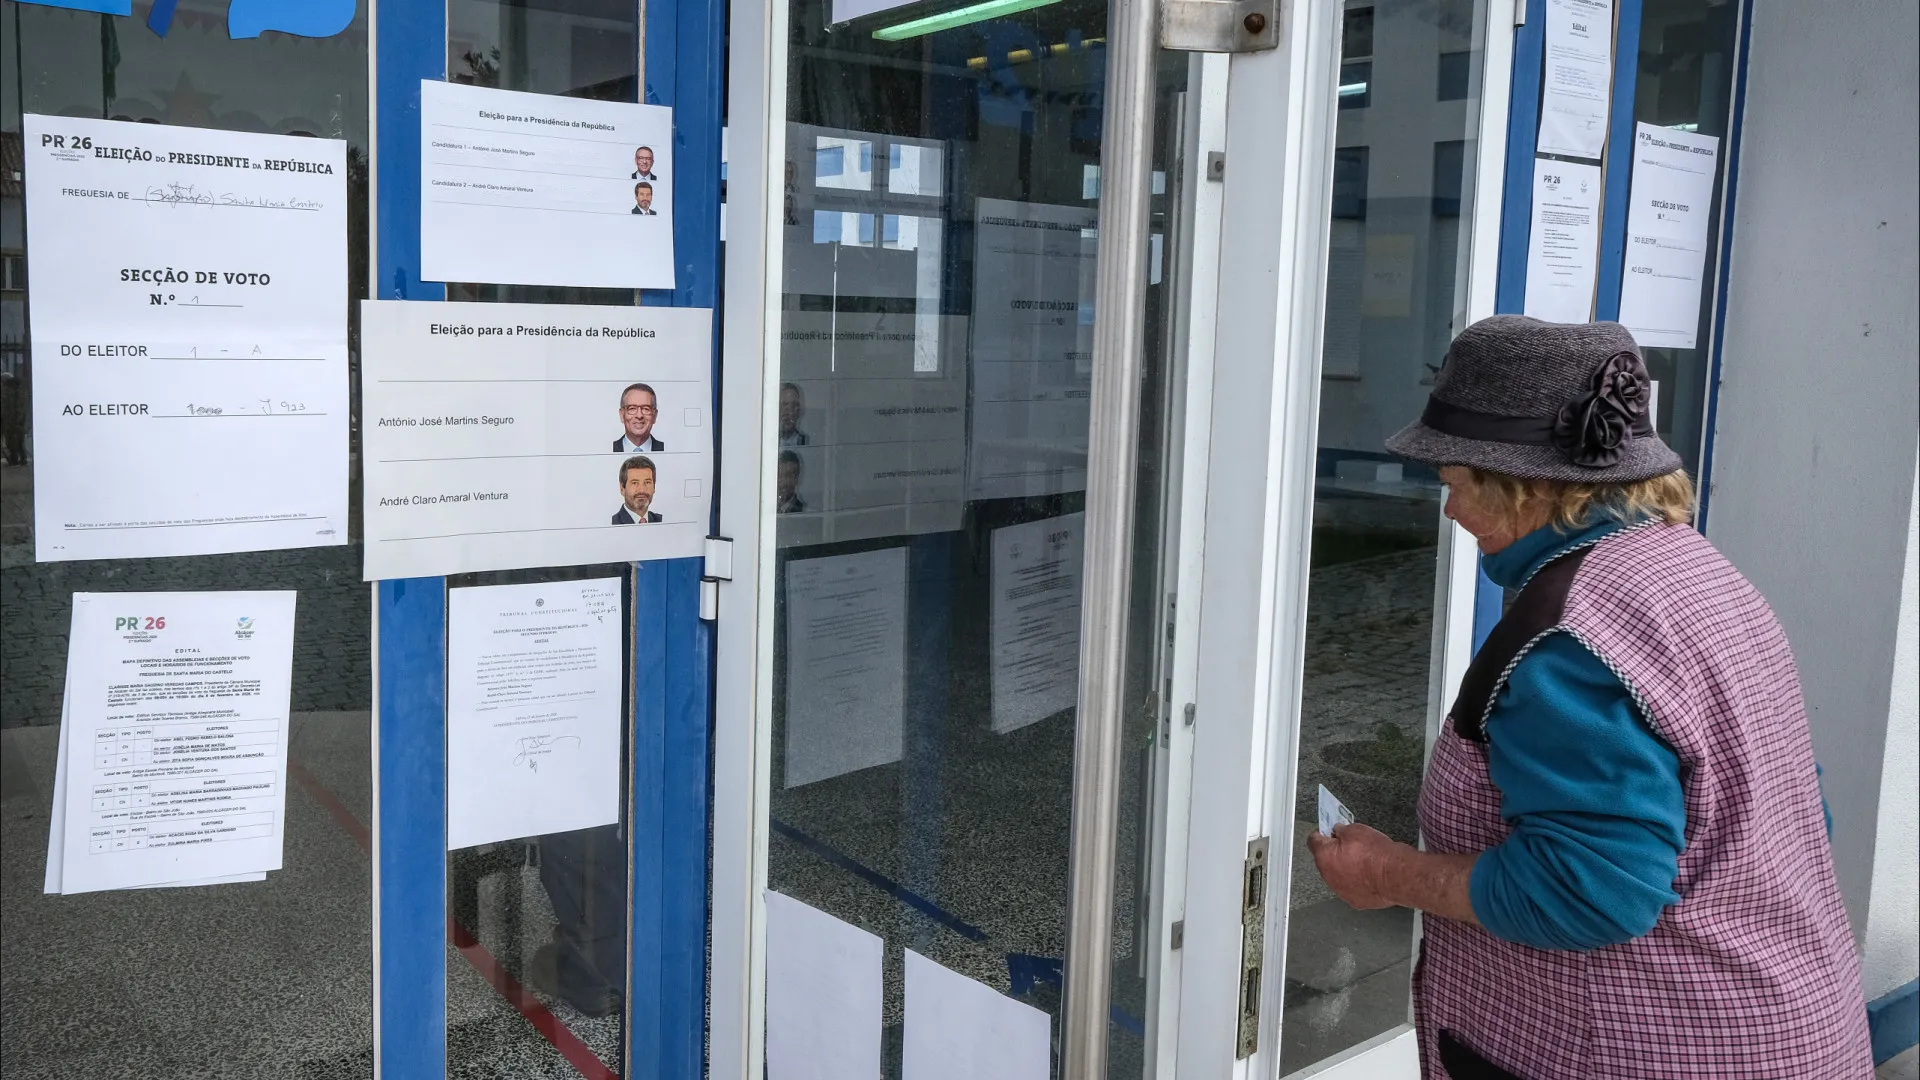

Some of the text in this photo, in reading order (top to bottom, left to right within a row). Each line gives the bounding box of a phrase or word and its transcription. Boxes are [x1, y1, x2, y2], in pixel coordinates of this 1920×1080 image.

[479, 110, 505, 120] Eleição
[506, 115, 522, 123] para
[530, 116, 570, 127] Presidência
[581, 122, 615, 132] República
[71, 136, 92, 150] 26
[431, 141, 463, 150] Candidatura
[94, 147, 152, 163] ELEIÇÃO
[168, 152, 249, 169] PRESIDENTE
[264, 158, 333, 175] REPÚBLICA
[431, 179, 462, 188] Candidatura
[1544, 175, 1561, 184] PR 26
[62, 188, 115, 199] FREGUESIA
[1651, 200, 1669, 209] SECÇÃO
[1677, 203, 1690, 213] VOTO
[1641, 237, 1657, 245] ELEITOR
[120, 267, 271, 286] SECÇÃO DE VOTO
[150, 294, 176, 306] N.º
[430, 324, 656, 340] Eleição para a Presidência da República
[61, 344, 148, 357] DO ELEITOR
[251, 344, 262, 355] A
[62, 404, 149, 416] AO ELEITOR
[281, 401, 306, 412] 923
[378, 415, 514, 427] António José Martins Seguro
[380, 491, 509, 507] André Claro Amaral Ventura
[144, 616, 166, 630] 26
